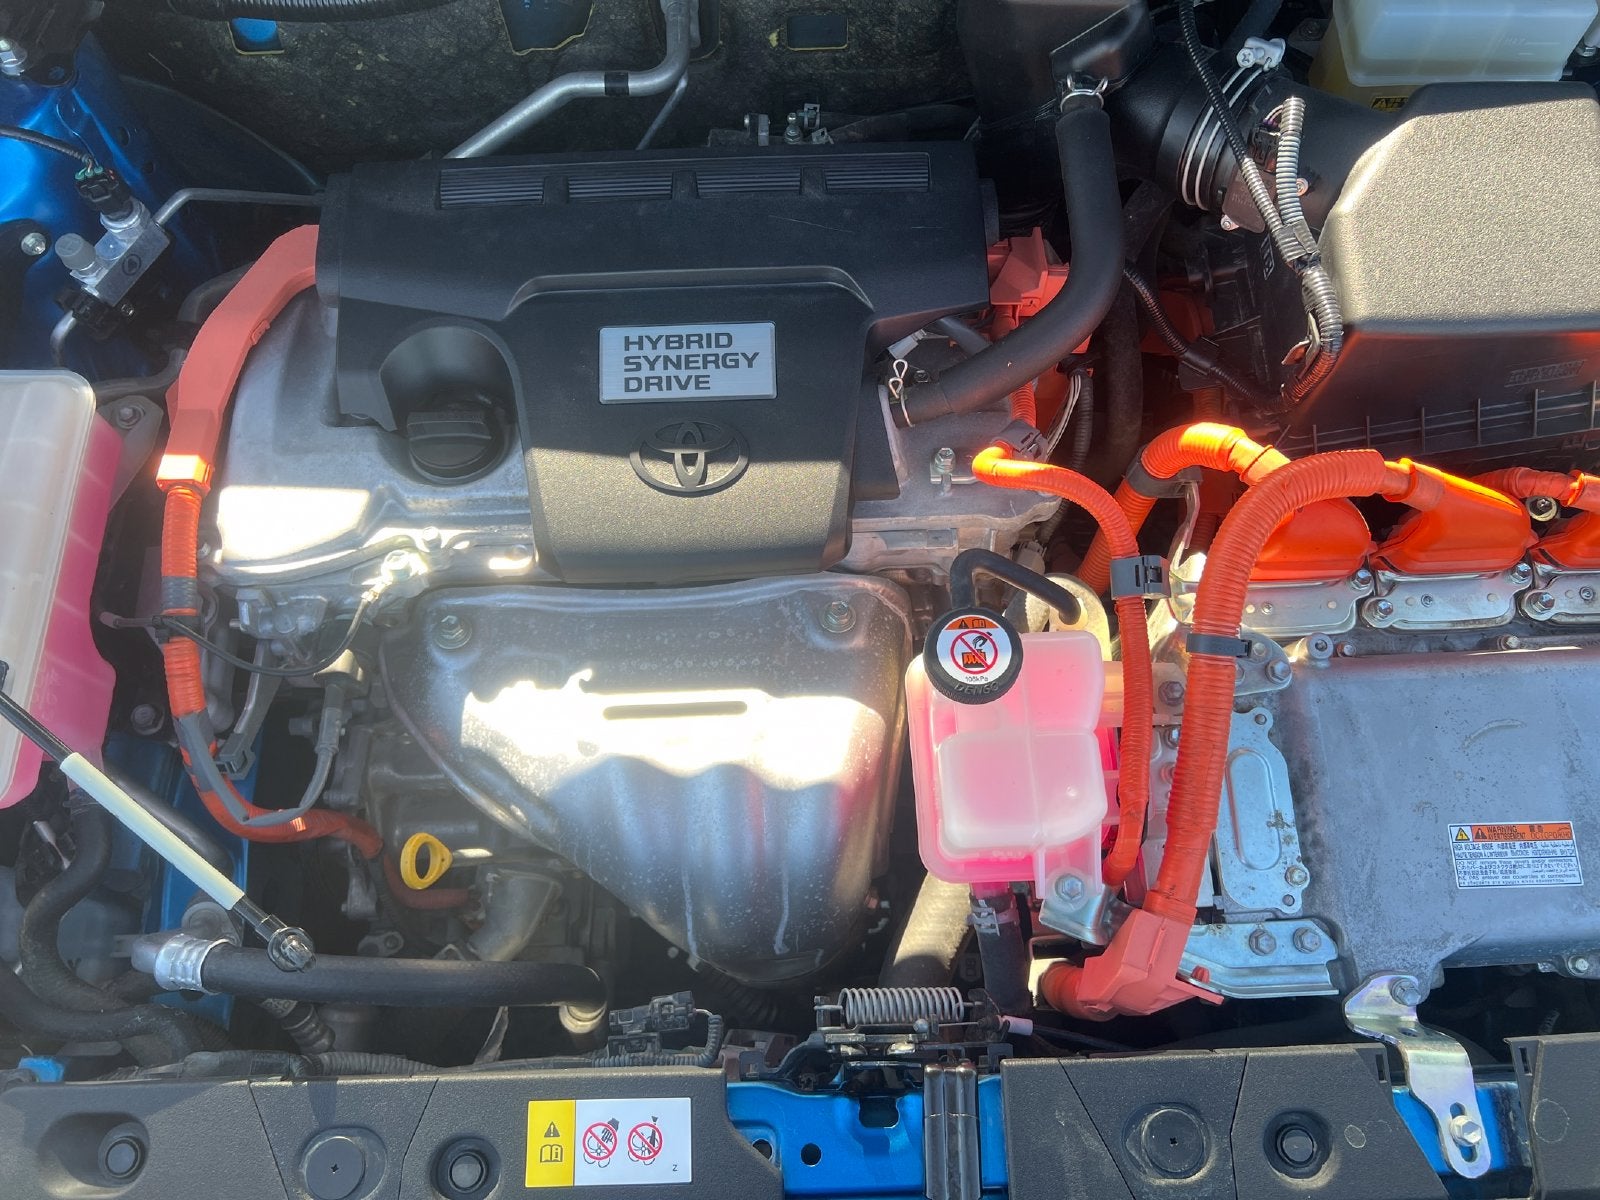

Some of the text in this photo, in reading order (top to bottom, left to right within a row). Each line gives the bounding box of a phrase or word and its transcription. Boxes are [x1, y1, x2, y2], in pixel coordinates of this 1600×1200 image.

[624, 332, 733, 351] HYBRID
[623, 352, 760, 372] SYNERGY
[624, 374, 711, 393] DRIVE
[954, 682, 999, 695] DENSO
[1487, 825, 1517, 833] WARNING
[672, 1164, 678, 1172] Z
